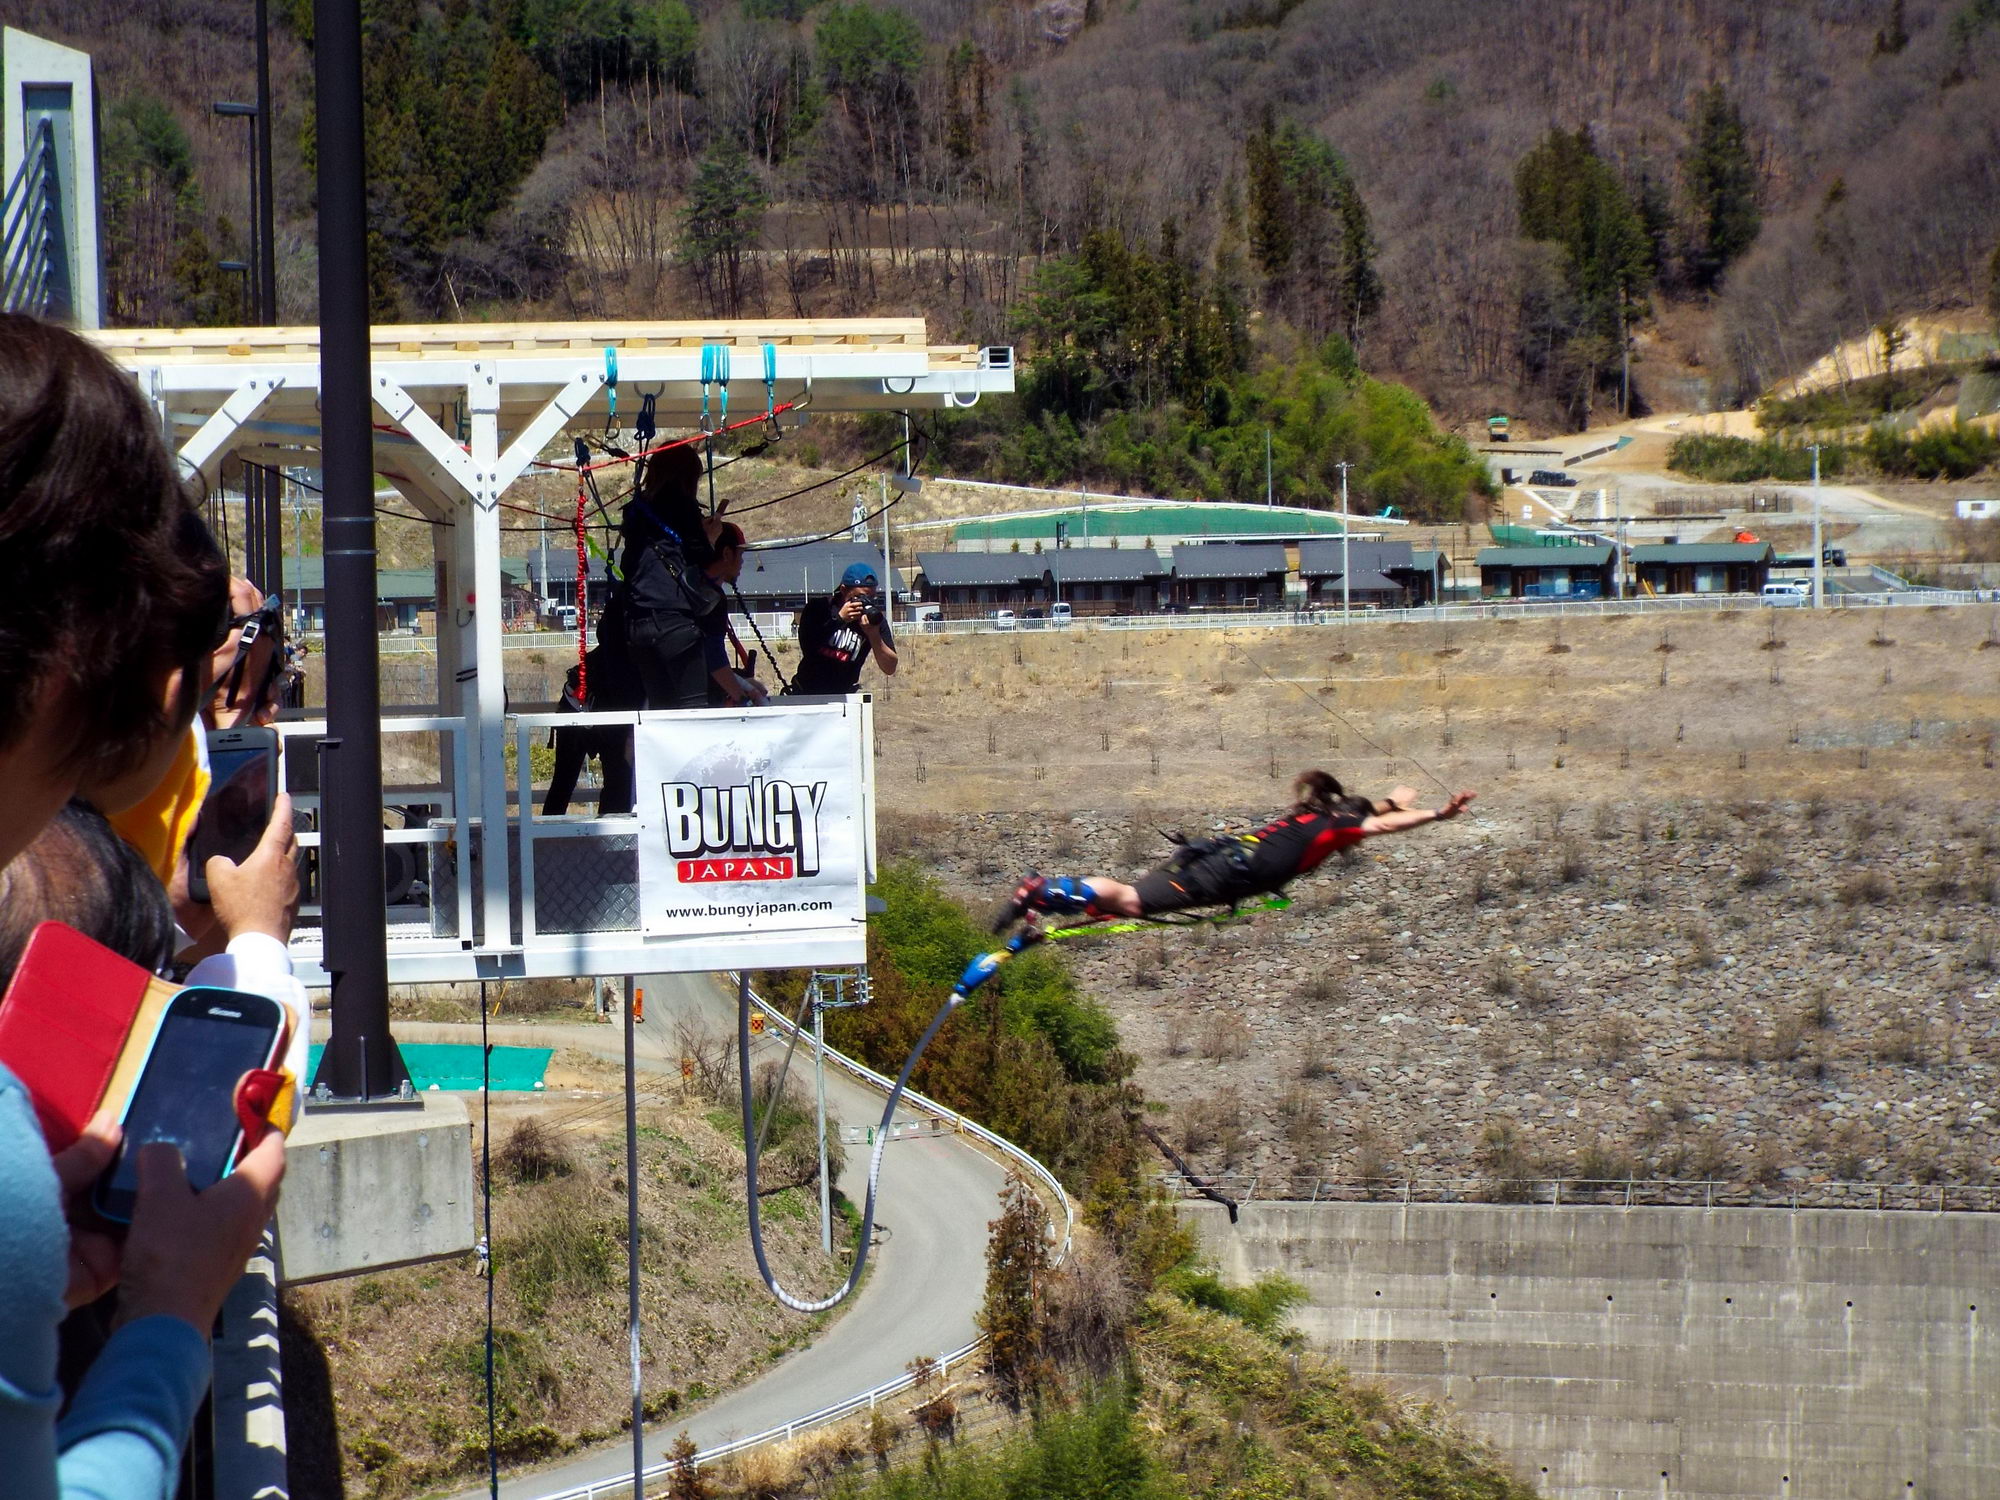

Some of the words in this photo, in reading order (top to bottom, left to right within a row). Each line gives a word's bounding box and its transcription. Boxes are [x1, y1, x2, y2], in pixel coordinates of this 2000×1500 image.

[661, 775, 828, 878] BUNGY
[686, 861, 785, 881] JAPAN
[666, 901, 833, 918] www.bungyjapan.com
